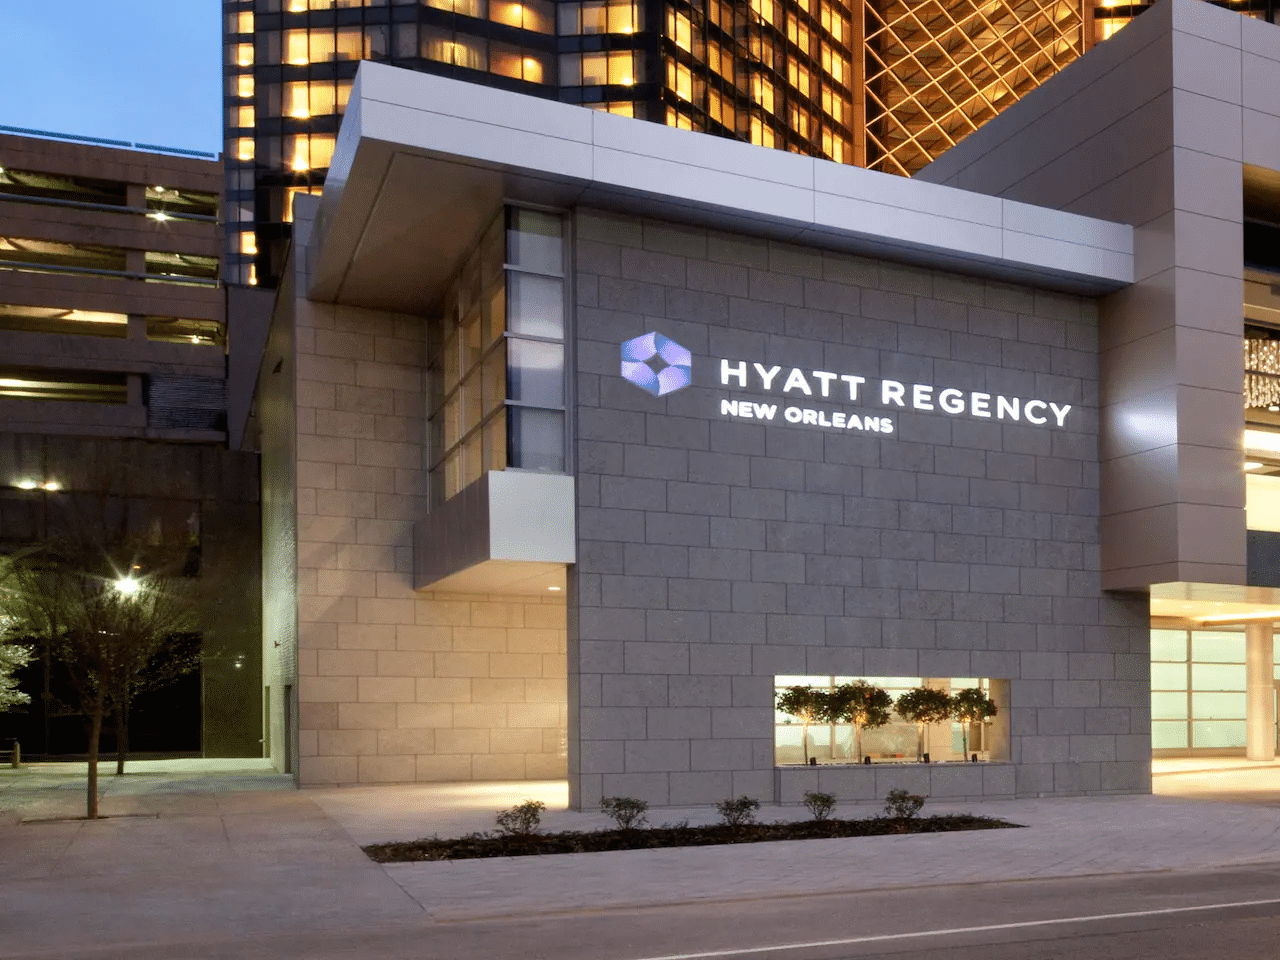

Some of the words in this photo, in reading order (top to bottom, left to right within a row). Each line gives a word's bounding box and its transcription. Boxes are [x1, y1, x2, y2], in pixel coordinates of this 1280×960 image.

[720, 358, 866, 401] HYATT
[881, 379, 1072, 428] REGENCY
[720, 399, 778, 421] NEW
[784, 406, 894, 434] ORLEANS
